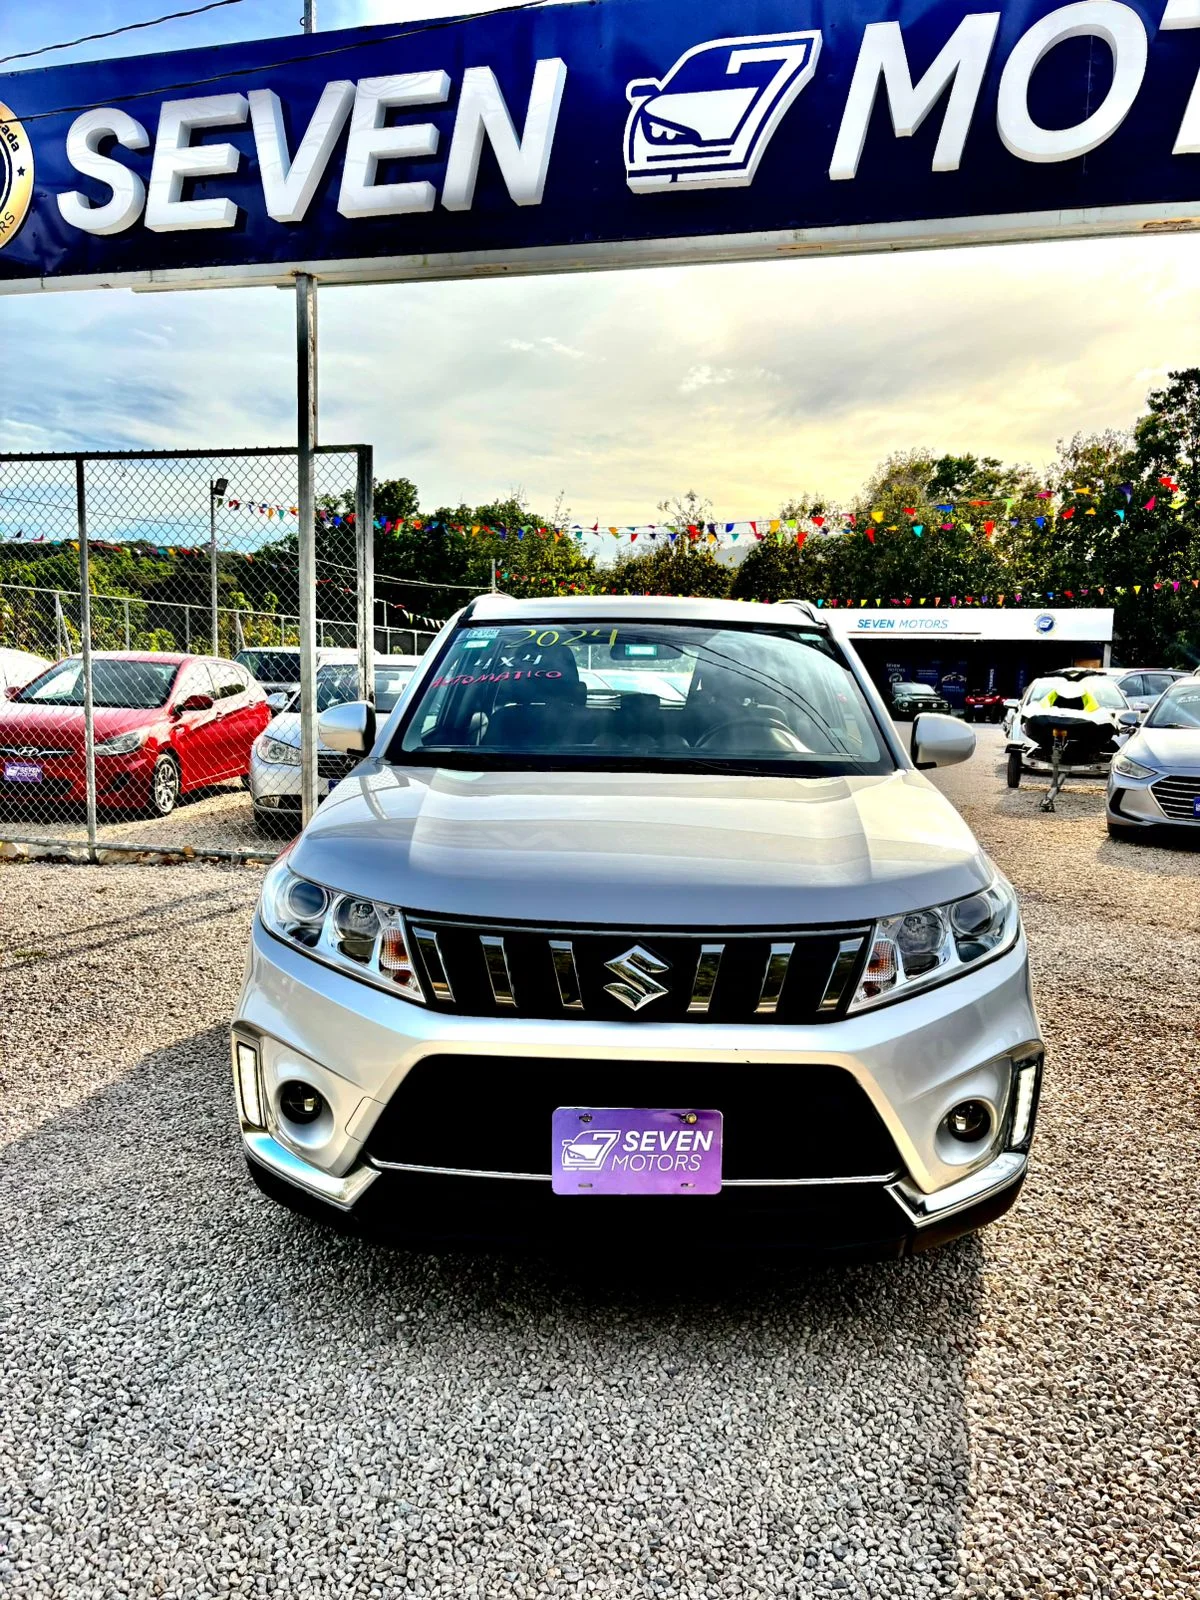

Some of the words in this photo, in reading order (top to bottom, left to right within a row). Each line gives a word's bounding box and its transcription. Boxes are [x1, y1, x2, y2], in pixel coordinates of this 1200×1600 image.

[0, 124, 20, 152] ada
[57, 57, 567, 235] SEVEN
[0, 211, 16, 234] RS
[857, 619, 895, 629] SEVEN
[898, 619, 949, 629] MOTORS
[504, 628, 618, 649] 2024
[622, 1130, 714, 1152] SEVEN
[611, 1154, 702, 1172] MOTORS
